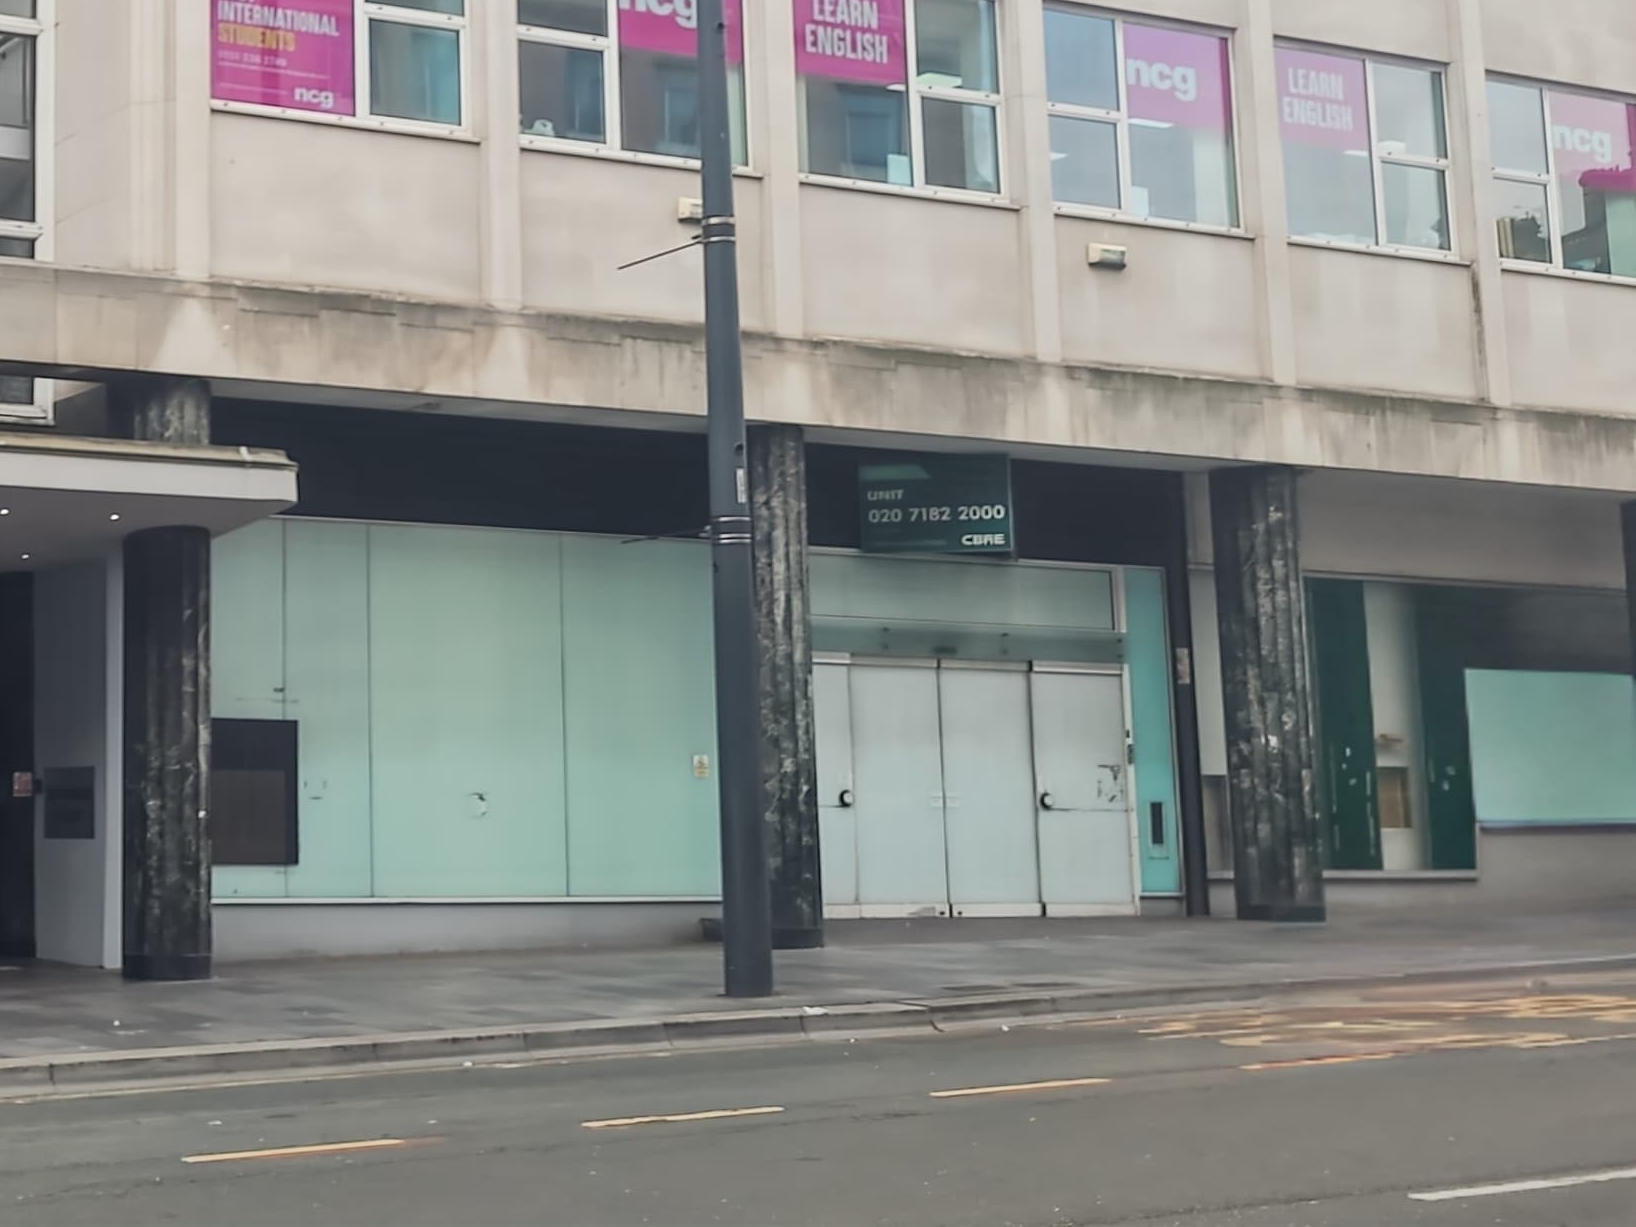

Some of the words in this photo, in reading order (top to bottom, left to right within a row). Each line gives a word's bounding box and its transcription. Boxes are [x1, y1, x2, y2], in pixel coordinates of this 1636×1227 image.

[218, 0, 340, 36] INTERNATIONAL
[219, 22, 296, 51] STUDENTS
[805, 23, 888, 64] ENGLISH
[294, 86, 335, 108] ncg
[1126, 59, 1196, 102] ncg
[1288, 67, 1343, 101] LEARN
[1283, 96, 1353, 131] ENGLISH
[1553, 125, 1612, 164] ncg
[867, 489, 905, 501] UNIT
[868, 508, 903, 523] 020
[909, 506, 952, 522] 7182
[958, 504, 1006, 521] 2000
[961, 533, 1007, 546] CBRE
